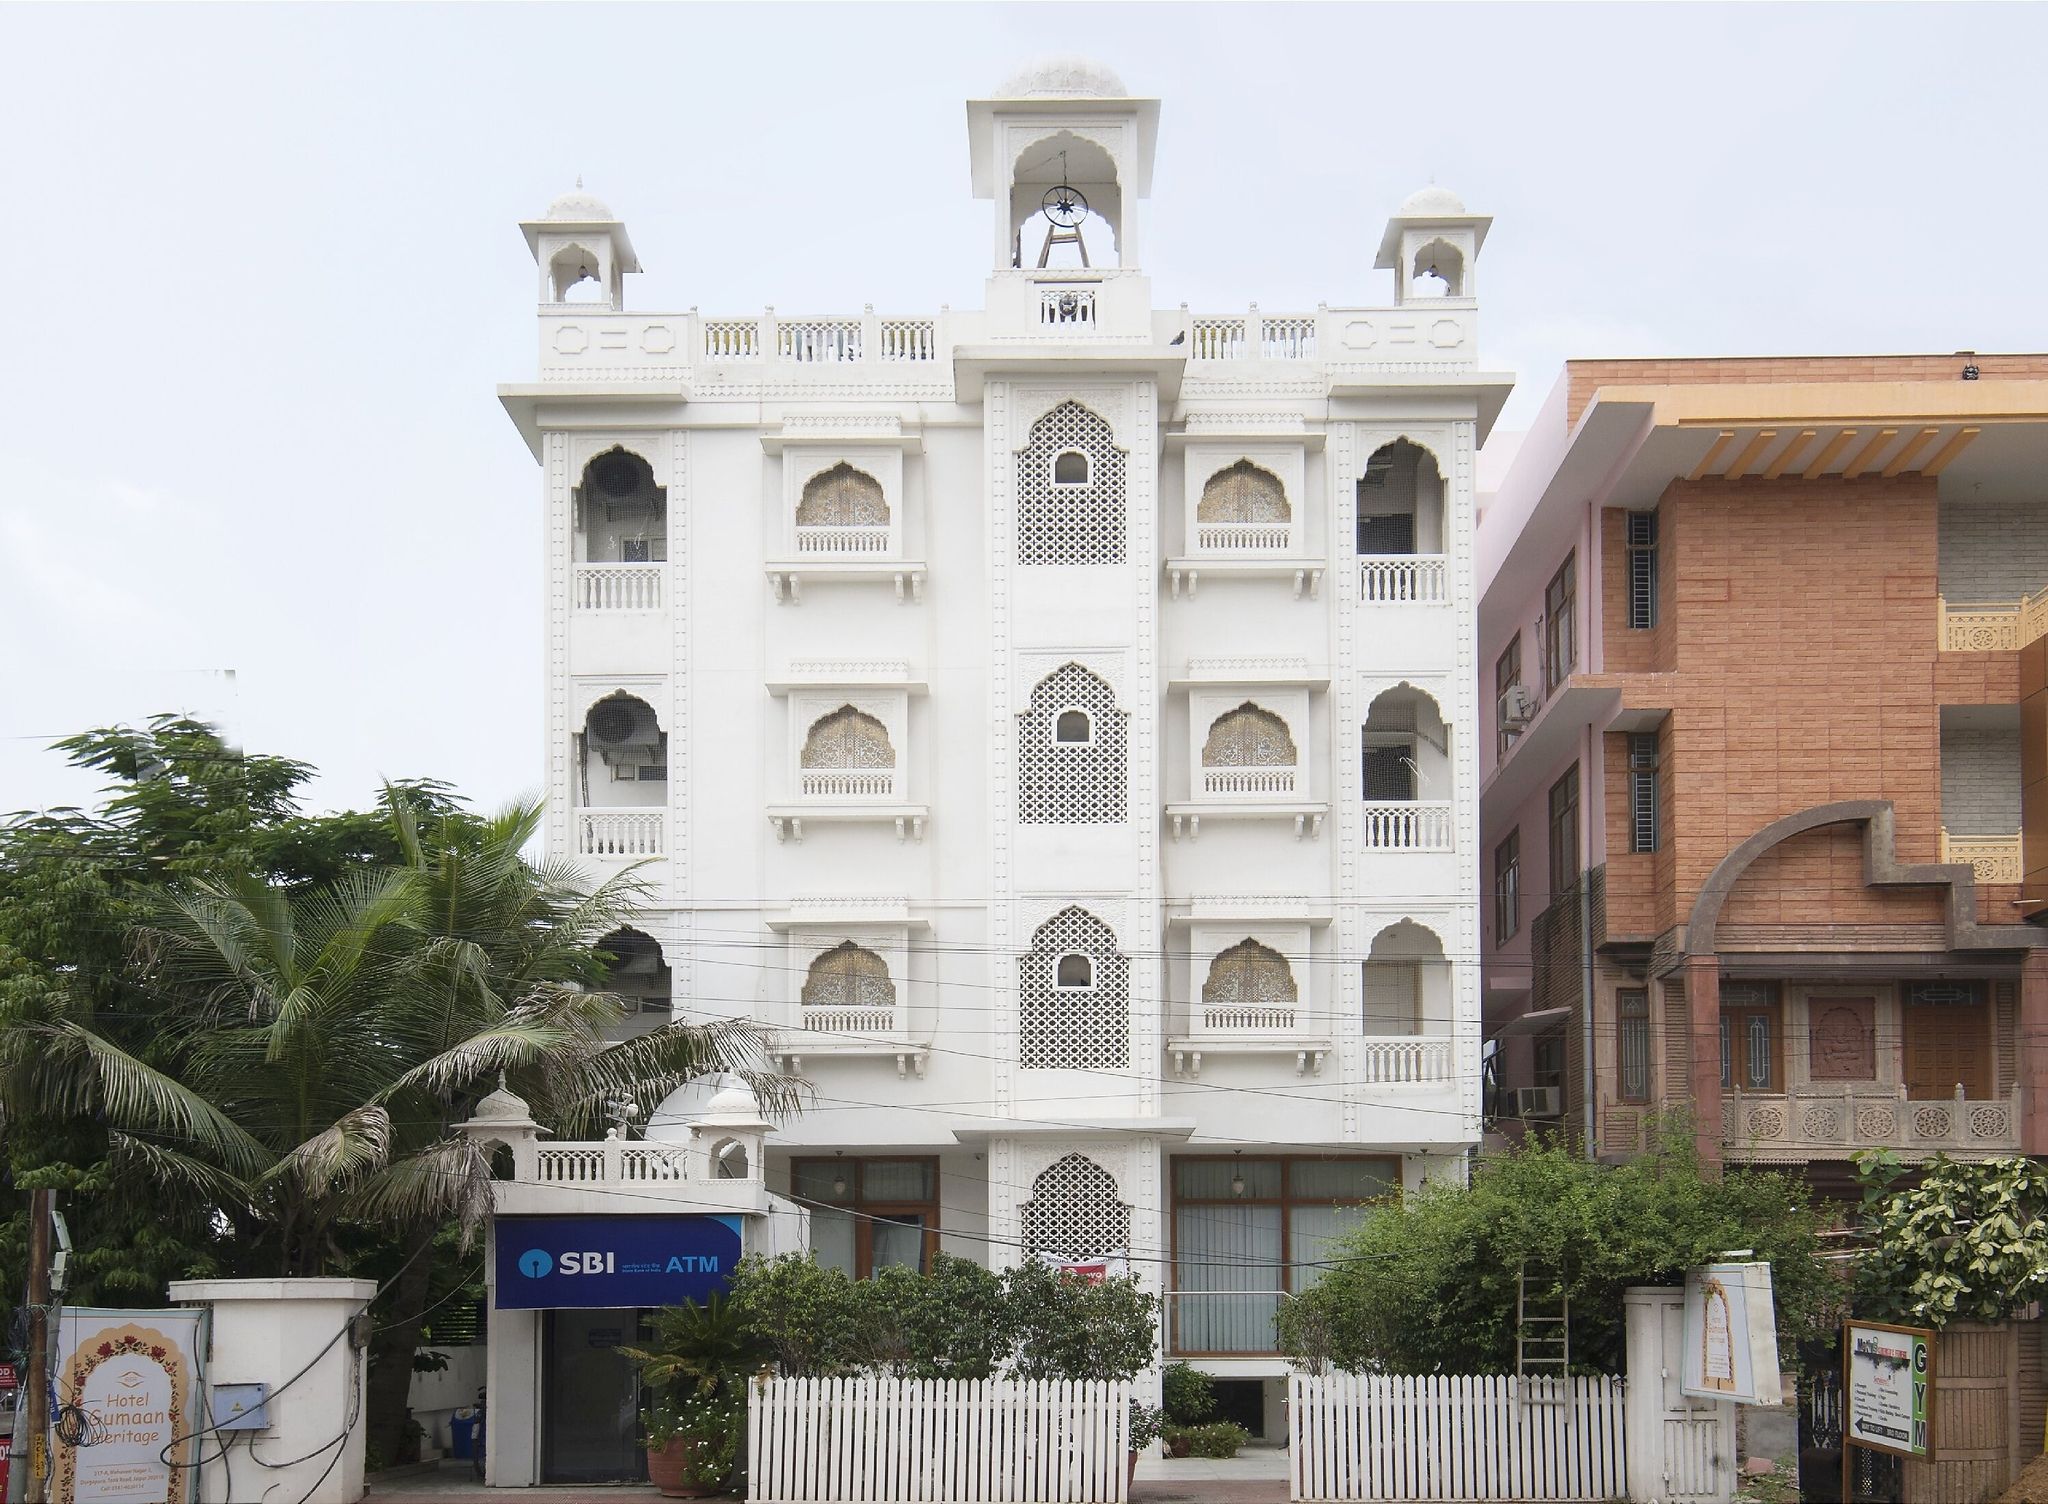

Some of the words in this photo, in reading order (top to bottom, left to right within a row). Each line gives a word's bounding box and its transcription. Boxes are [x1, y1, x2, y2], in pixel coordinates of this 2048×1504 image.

[559, 1252, 615, 1275] SBI
[665, 1256, 718, 1273] ATM
[106, 1391, 150, 1408] Hotel
[1913, 1342, 1927, 1449] GYM
[89, 1409, 165, 1427] Gumaan
[91, 1429, 160, 1446] Heritage
